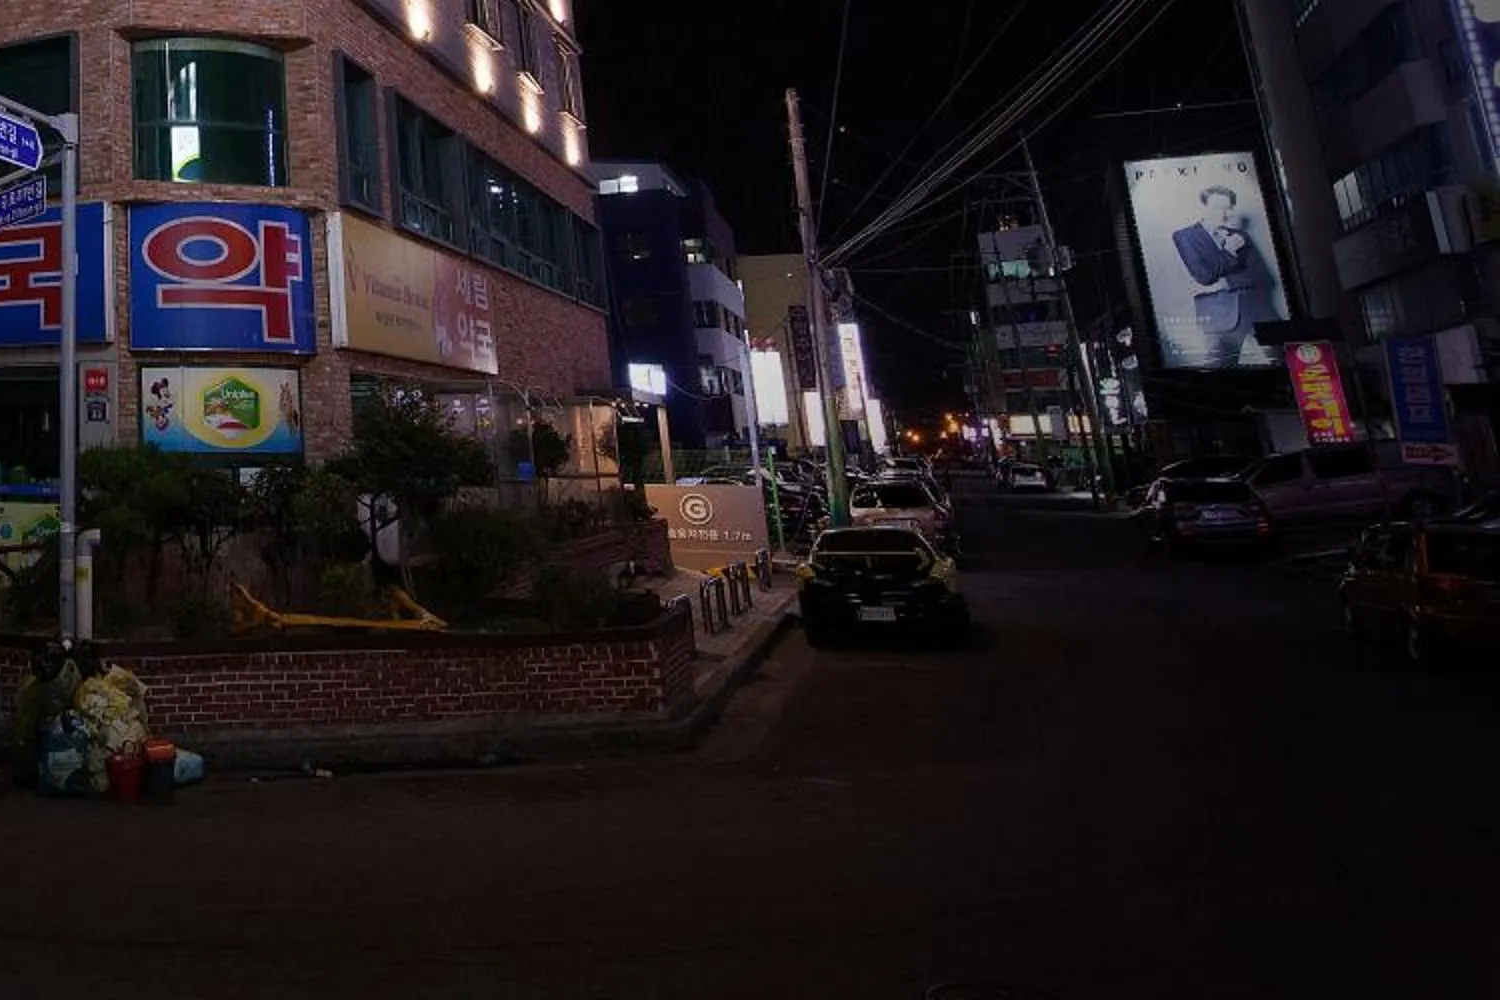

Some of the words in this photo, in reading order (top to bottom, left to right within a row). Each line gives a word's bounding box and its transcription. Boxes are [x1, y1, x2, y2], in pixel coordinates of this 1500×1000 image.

[141, 215, 303, 344] 약
[456, 266, 489, 311] 세림
[457, 311, 494, 364] 약국
